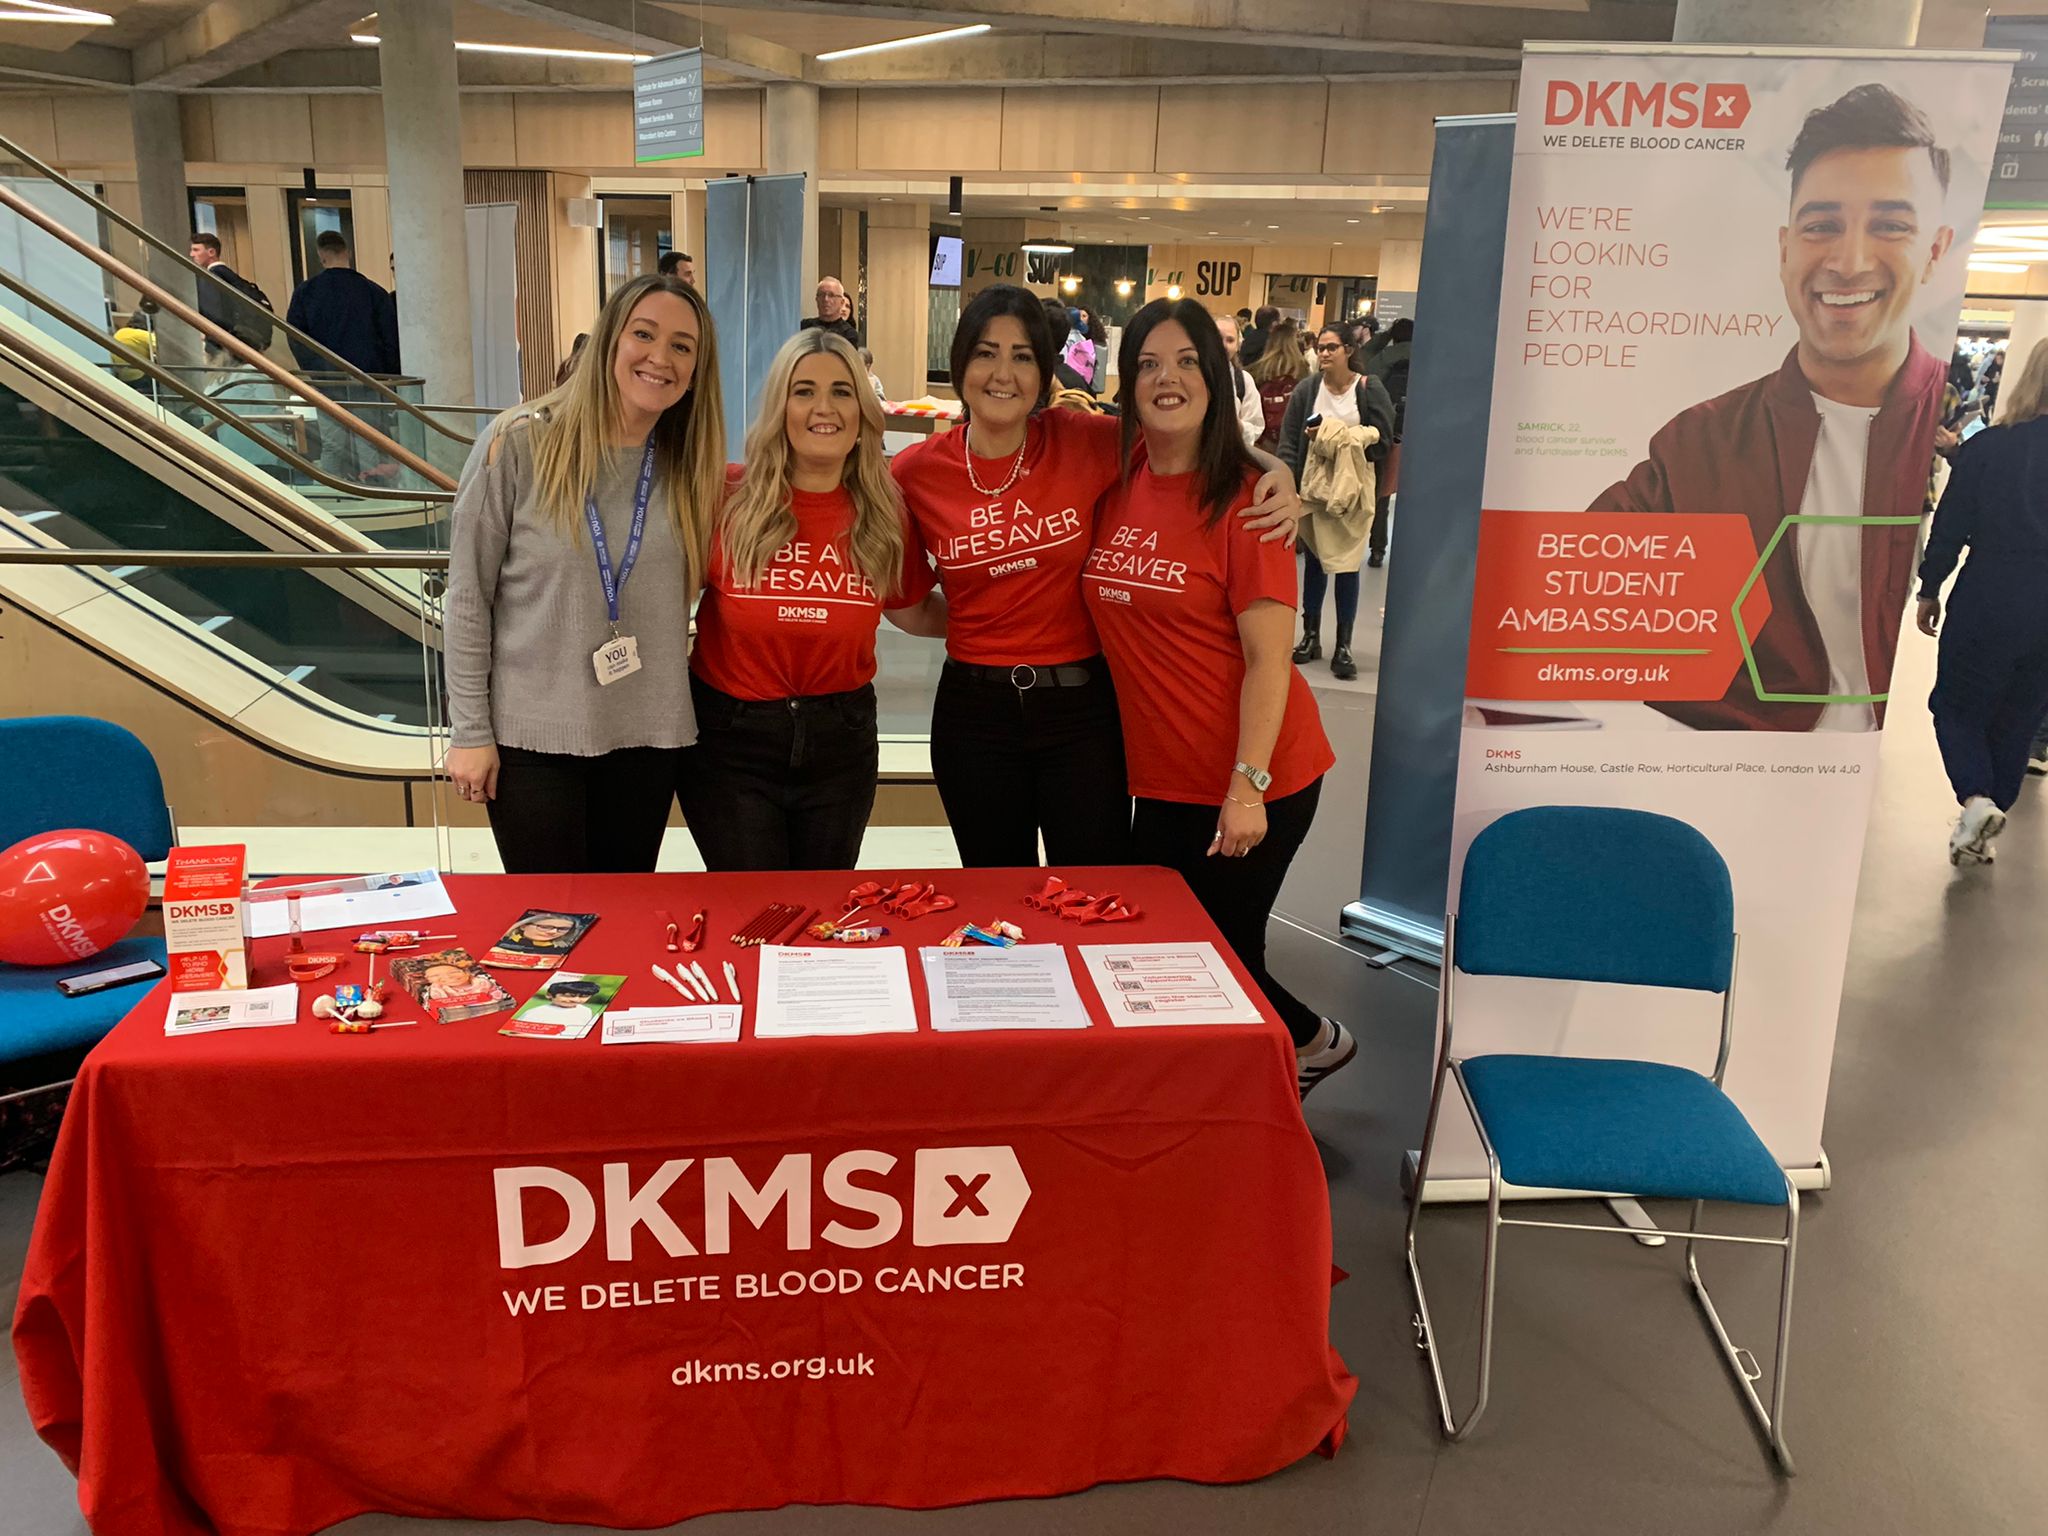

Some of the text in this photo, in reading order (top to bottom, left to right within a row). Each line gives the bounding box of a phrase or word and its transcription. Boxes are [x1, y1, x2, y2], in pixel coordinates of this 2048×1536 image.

[1543, 135, 1746, 151] WE DELETE BLOOD CANCER
[1537, 206, 1633, 232] WE'RE
[1533, 240, 1669, 267] LOOKING
[1196, 261, 1241, 296] SUP
[1530, 275, 1592, 299] FOR
[1526, 309, 1784, 337] EXTRAORDINARY
[1524, 343, 1639, 368] PEOPLE
[1514, 447, 1629, 457] and fundraiser for DKMS
[1515, 435, 1617, 445] blood cancer survivor
[971, 498, 1034, 528] BE A
[937, 507, 1081, 560] LIFESAVER
[1110, 525, 1158, 551] BE A
[775, 541, 841, 566] BE A
[1537, 533, 1697, 561] BECOME A
[1545, 570, 1685, 597] STUDENT
[1497, 606, 1719, 635] AMBASSADOR
[605, 646, 627, 663] YOU
[1536, 663, 1671, 685] dkms.org.uk
[1485, 748, 1522, 760] DKMS
[1484, 762, 1862, 775] Ashburnham House, Castle Row, Horticultural Place, London W4 4JQ
[175, 857, 210, 867] THANK
[170, 903, 219, 919] DKMS
[502, 1263, 1026, 1318] WE DELETE BLOOD CANCER
[671, 1352, 876, 1387] dkms.org.uk
